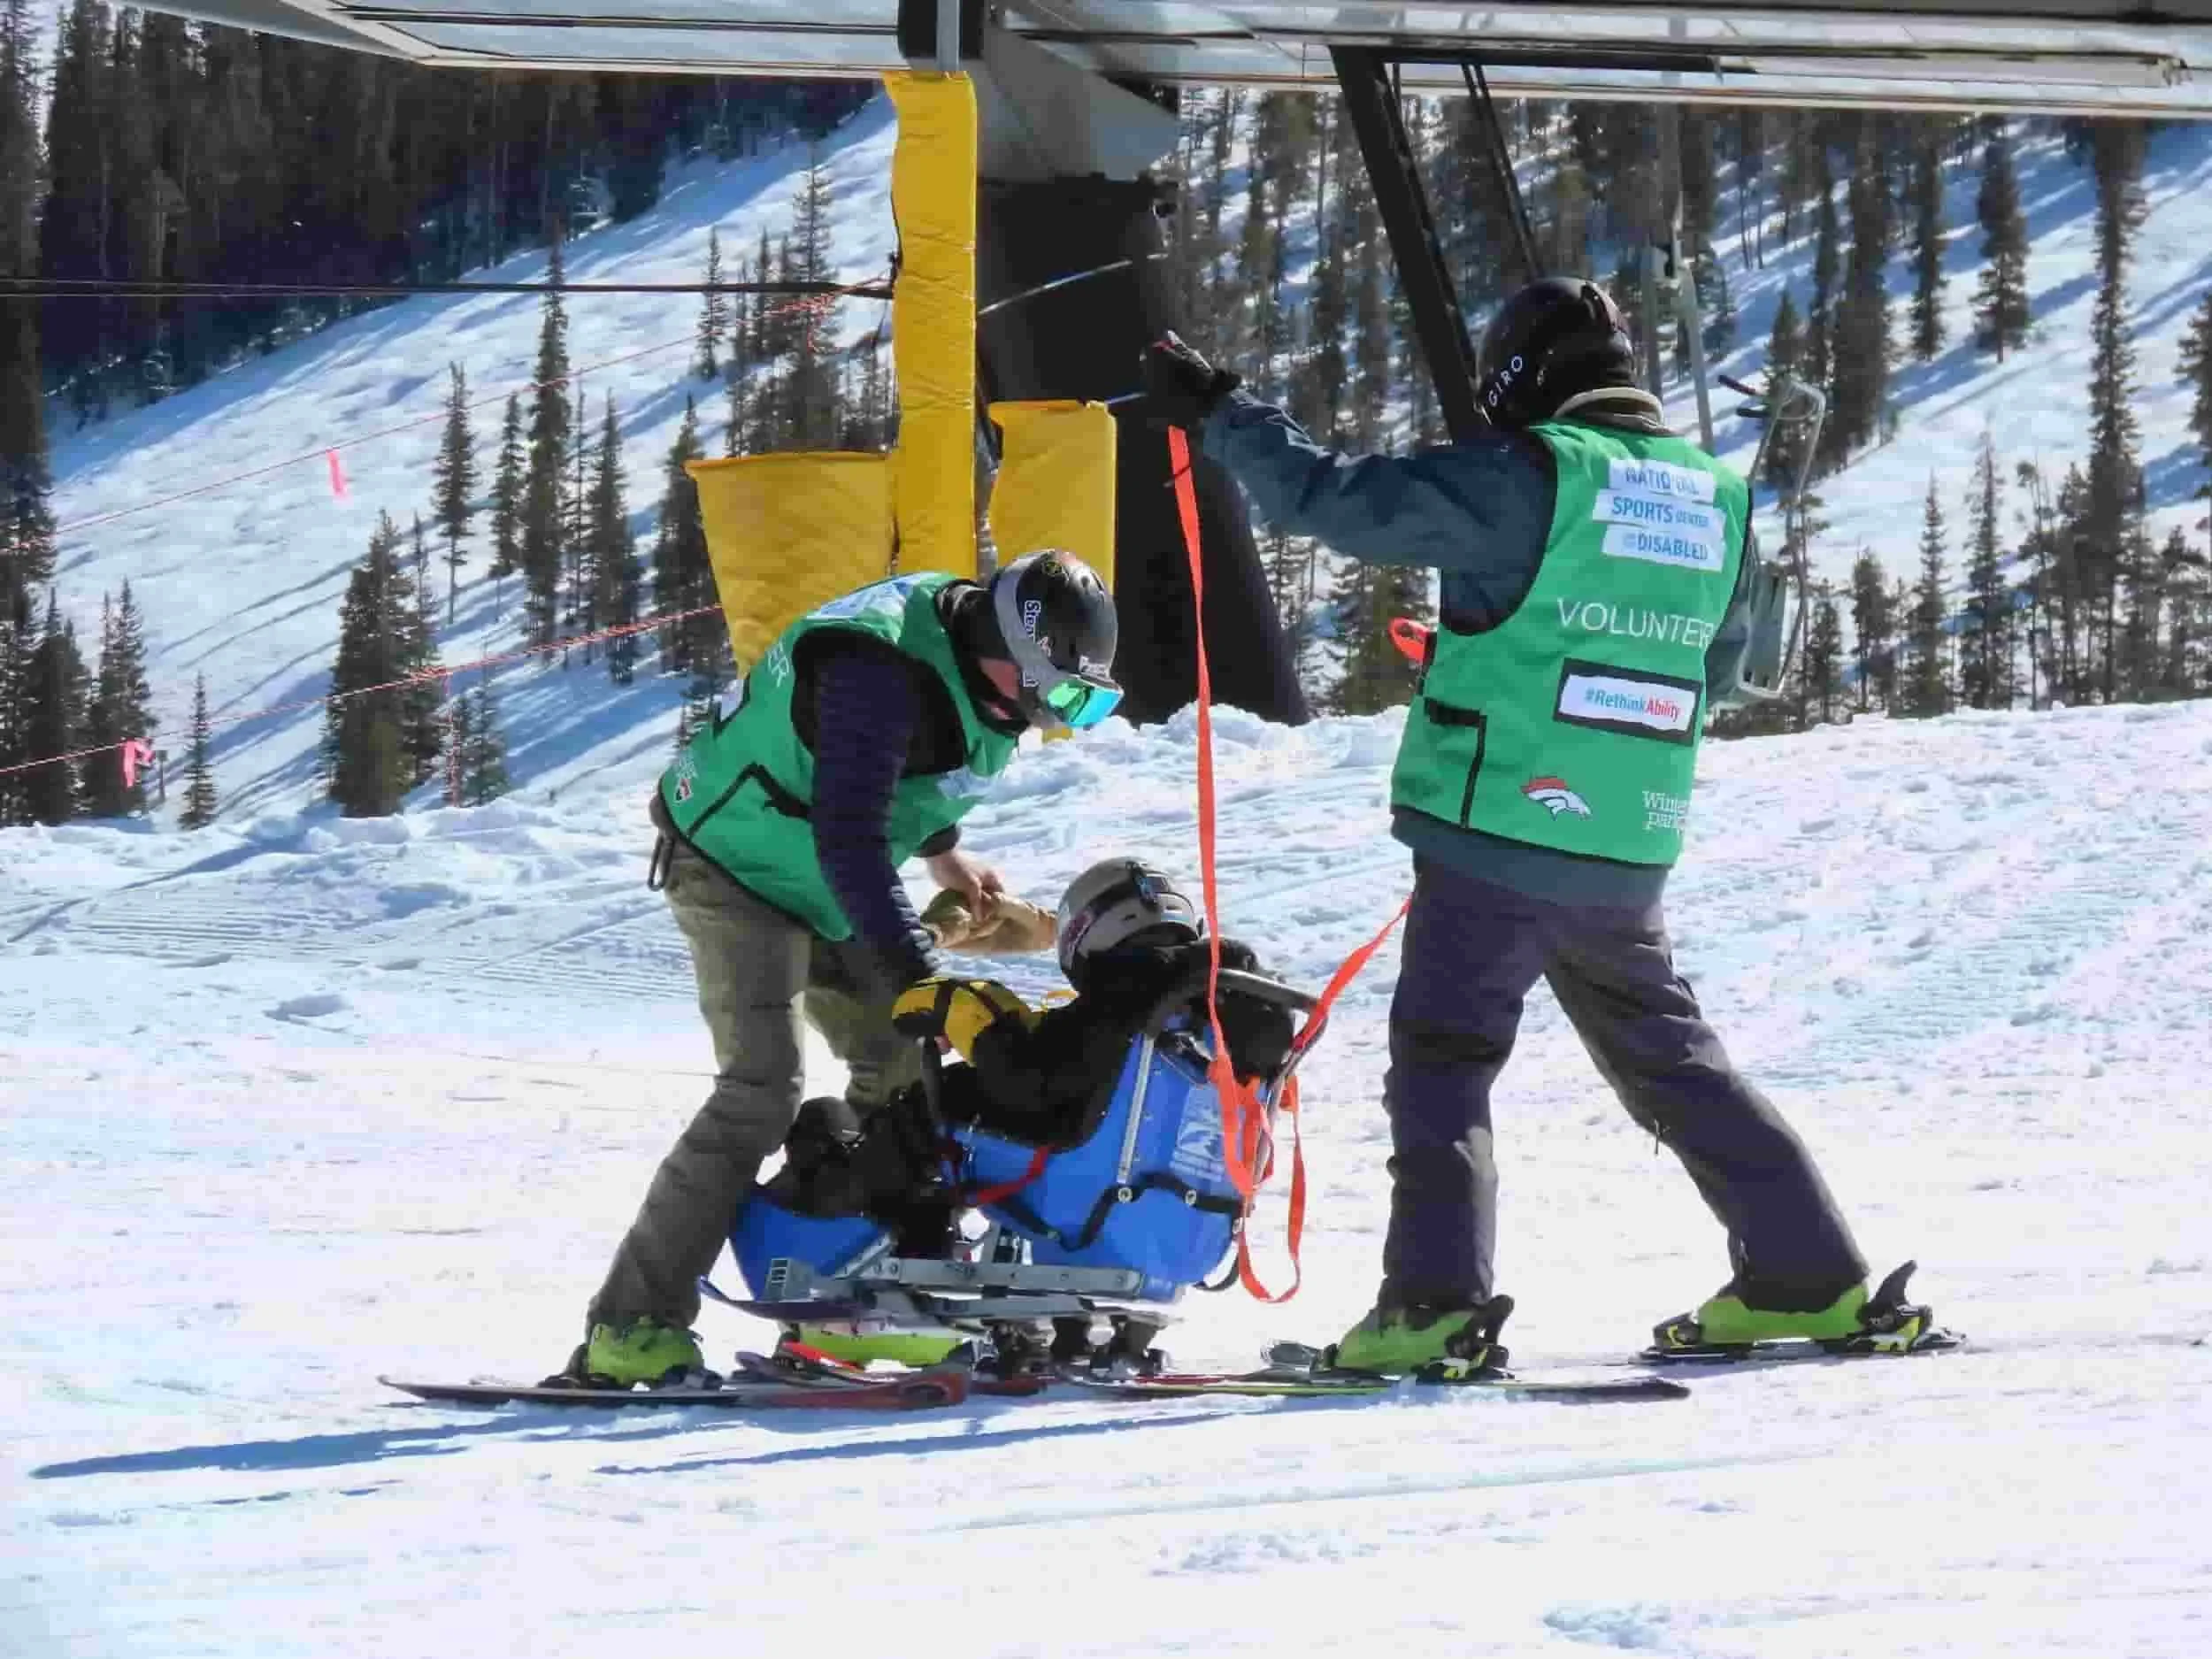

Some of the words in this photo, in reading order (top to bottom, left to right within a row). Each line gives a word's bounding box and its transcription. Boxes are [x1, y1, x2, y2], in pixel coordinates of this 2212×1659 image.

[1487, 355, 1524, 408] GIRO
[1611, 495, 1674, 524] SPORTS
[1637, 533, 1709, 560] DISABLED
[1584, 685, 1680, 723] #RethinkAbility
